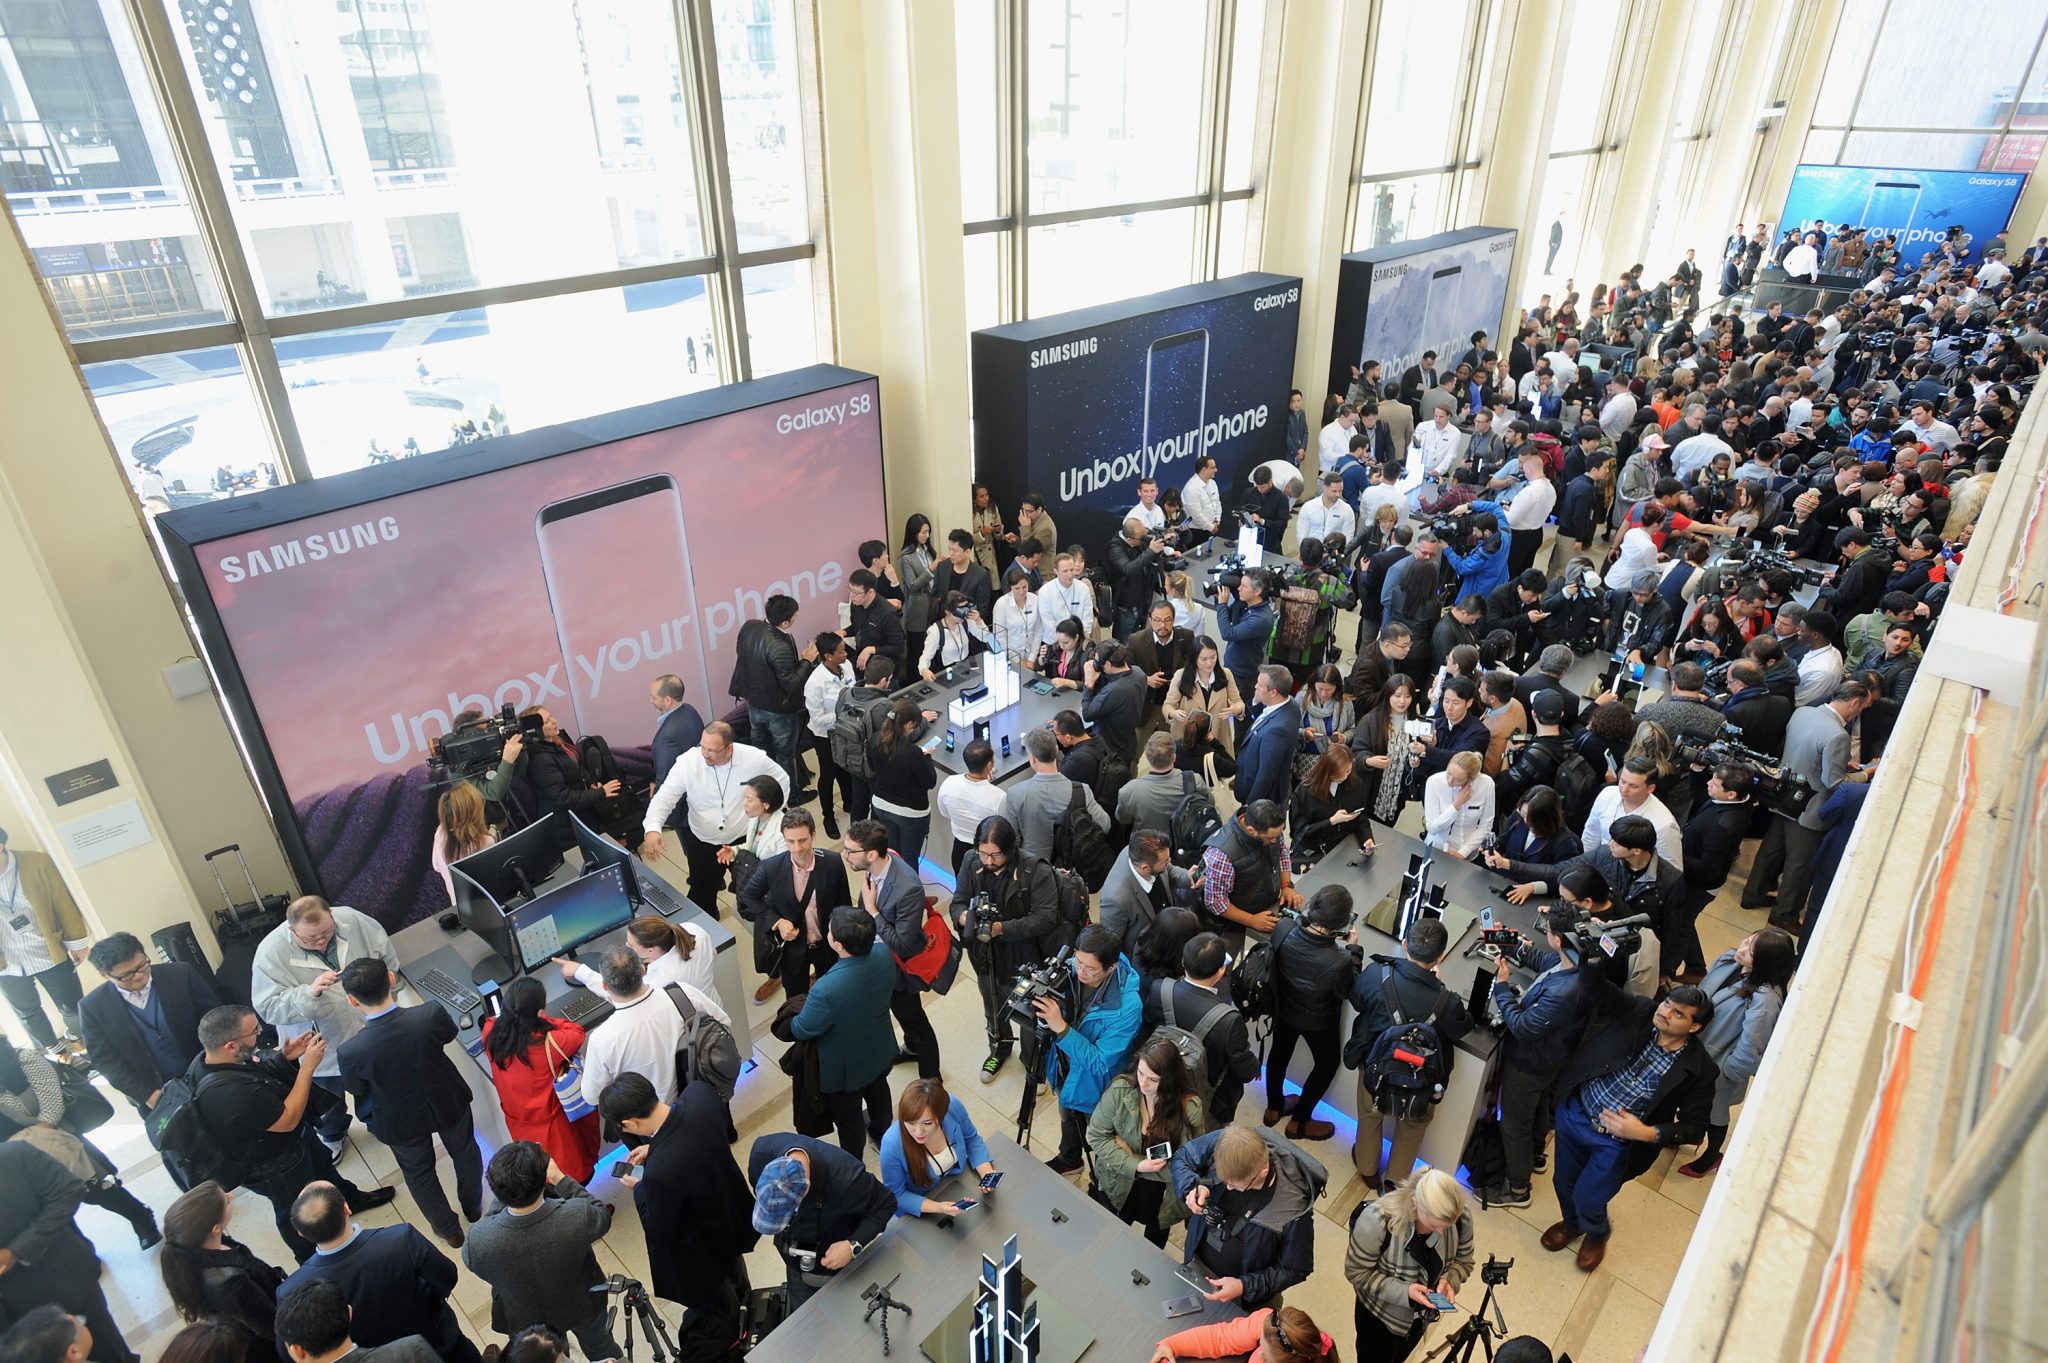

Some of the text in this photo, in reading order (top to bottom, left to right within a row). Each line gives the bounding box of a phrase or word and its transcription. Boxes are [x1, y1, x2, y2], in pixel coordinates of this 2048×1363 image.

[1968, 177, 2017, 188] Galaxy S8
[1373, 264, 1408, 282] SAMSUNG
[1254, 288, 1299, 311] Galaxy S8
[1030, 337, 1098, 369] SAMSUNG
[776, 394, 871, 434] Galaxy S8
[1060, 404, 1268, 502] Unbox your phone
[220, 516, 400, 583] SAMSUNG
[575, 614, 690, 699] your
[704, 561, 843, 650] phone
